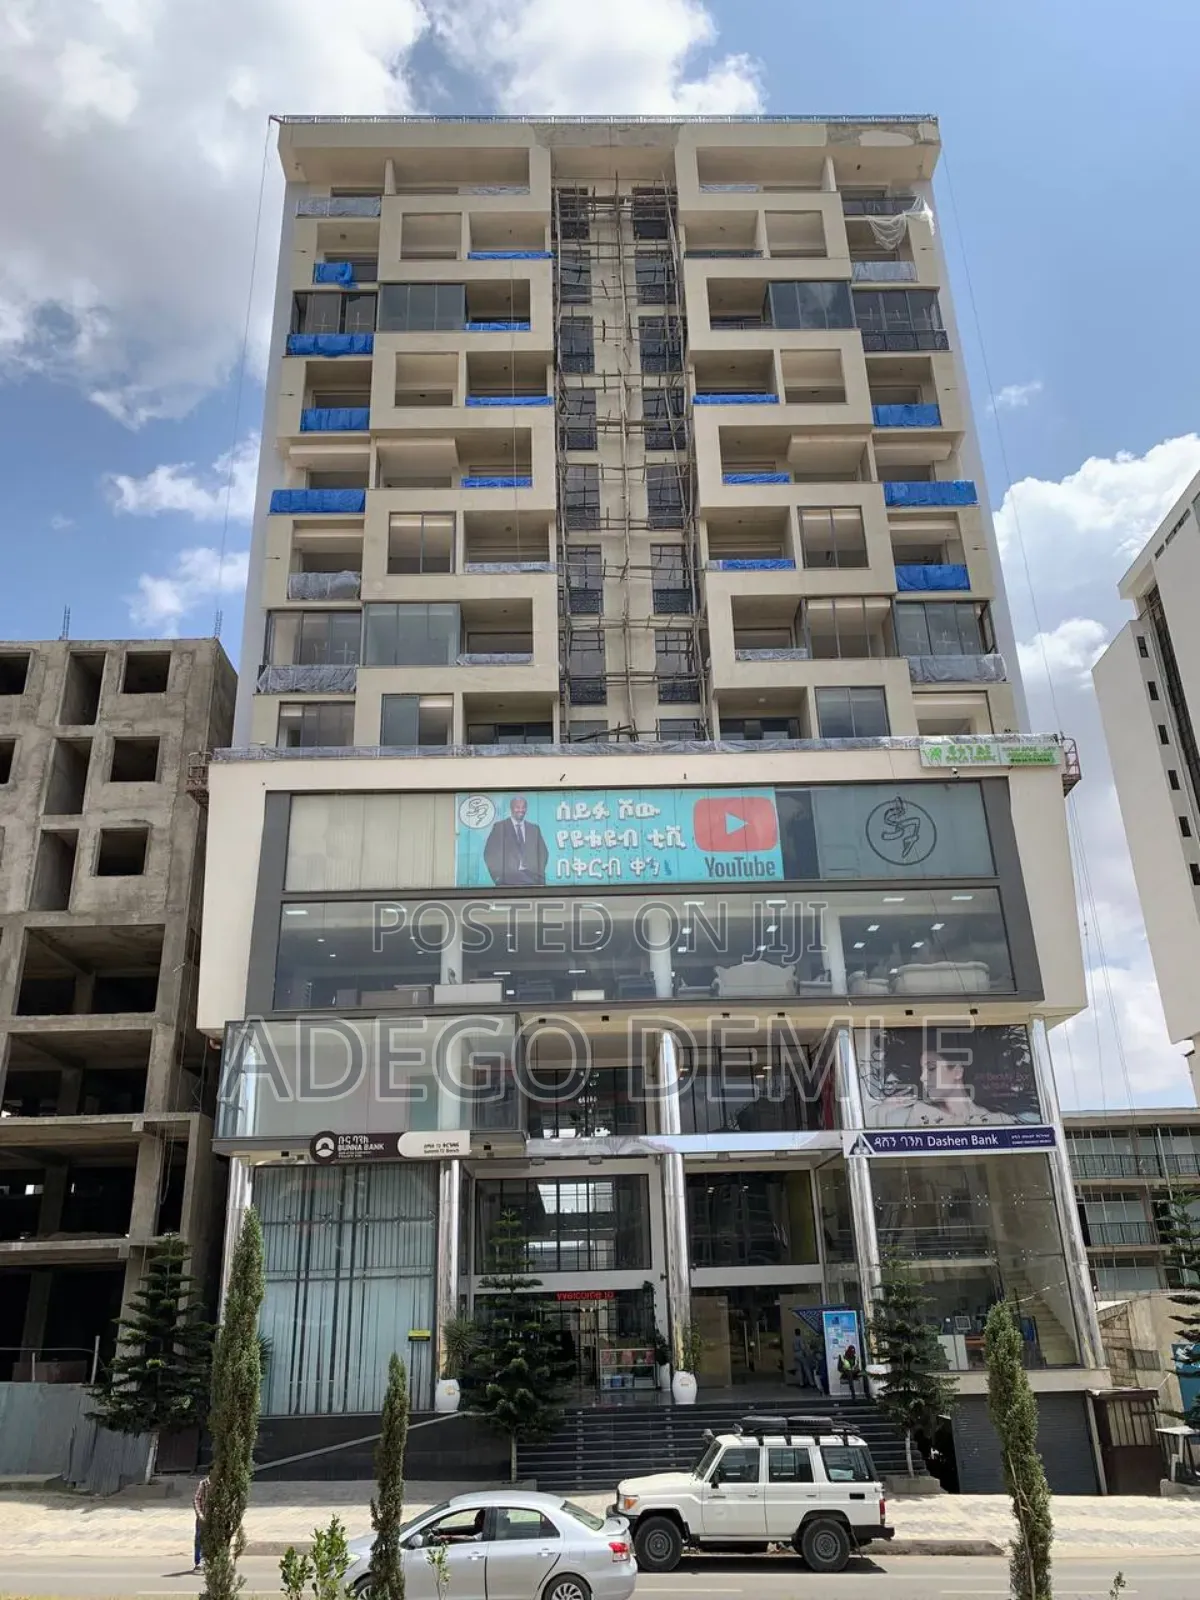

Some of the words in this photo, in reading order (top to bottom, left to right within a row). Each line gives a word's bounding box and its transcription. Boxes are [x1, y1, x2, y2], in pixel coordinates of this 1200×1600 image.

[705, 855, 776, 878] YouTube
[927, 1134, 969, 1147] Dashen
[971, 1133, 999, 1146] Bank
[556, 1292, 601, 1300] Welcome
